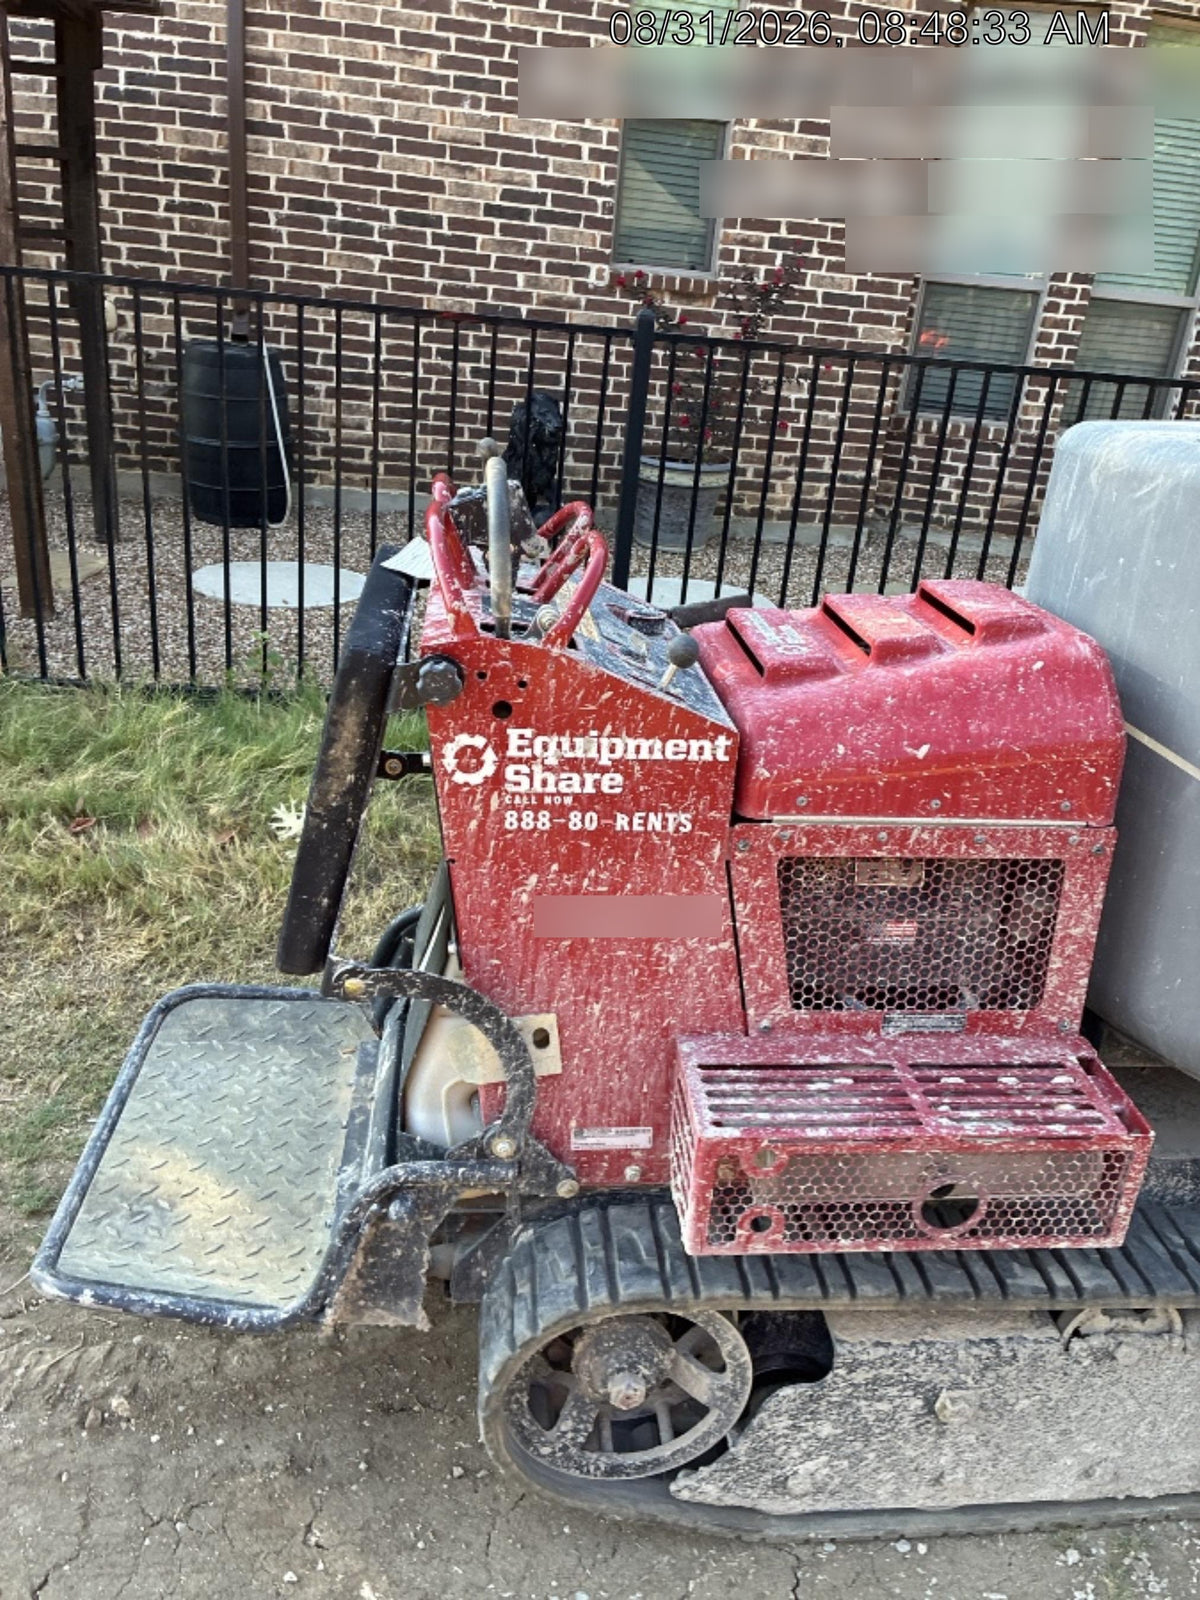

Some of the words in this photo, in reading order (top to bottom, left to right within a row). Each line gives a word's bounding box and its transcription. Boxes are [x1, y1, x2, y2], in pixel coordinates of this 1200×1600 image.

[506, 728, 731, 765] Equipment
[504, 764, 624, 794] Share
[504, 795, 538, 805] CALL
[543, 795, 574, 805] NOW
